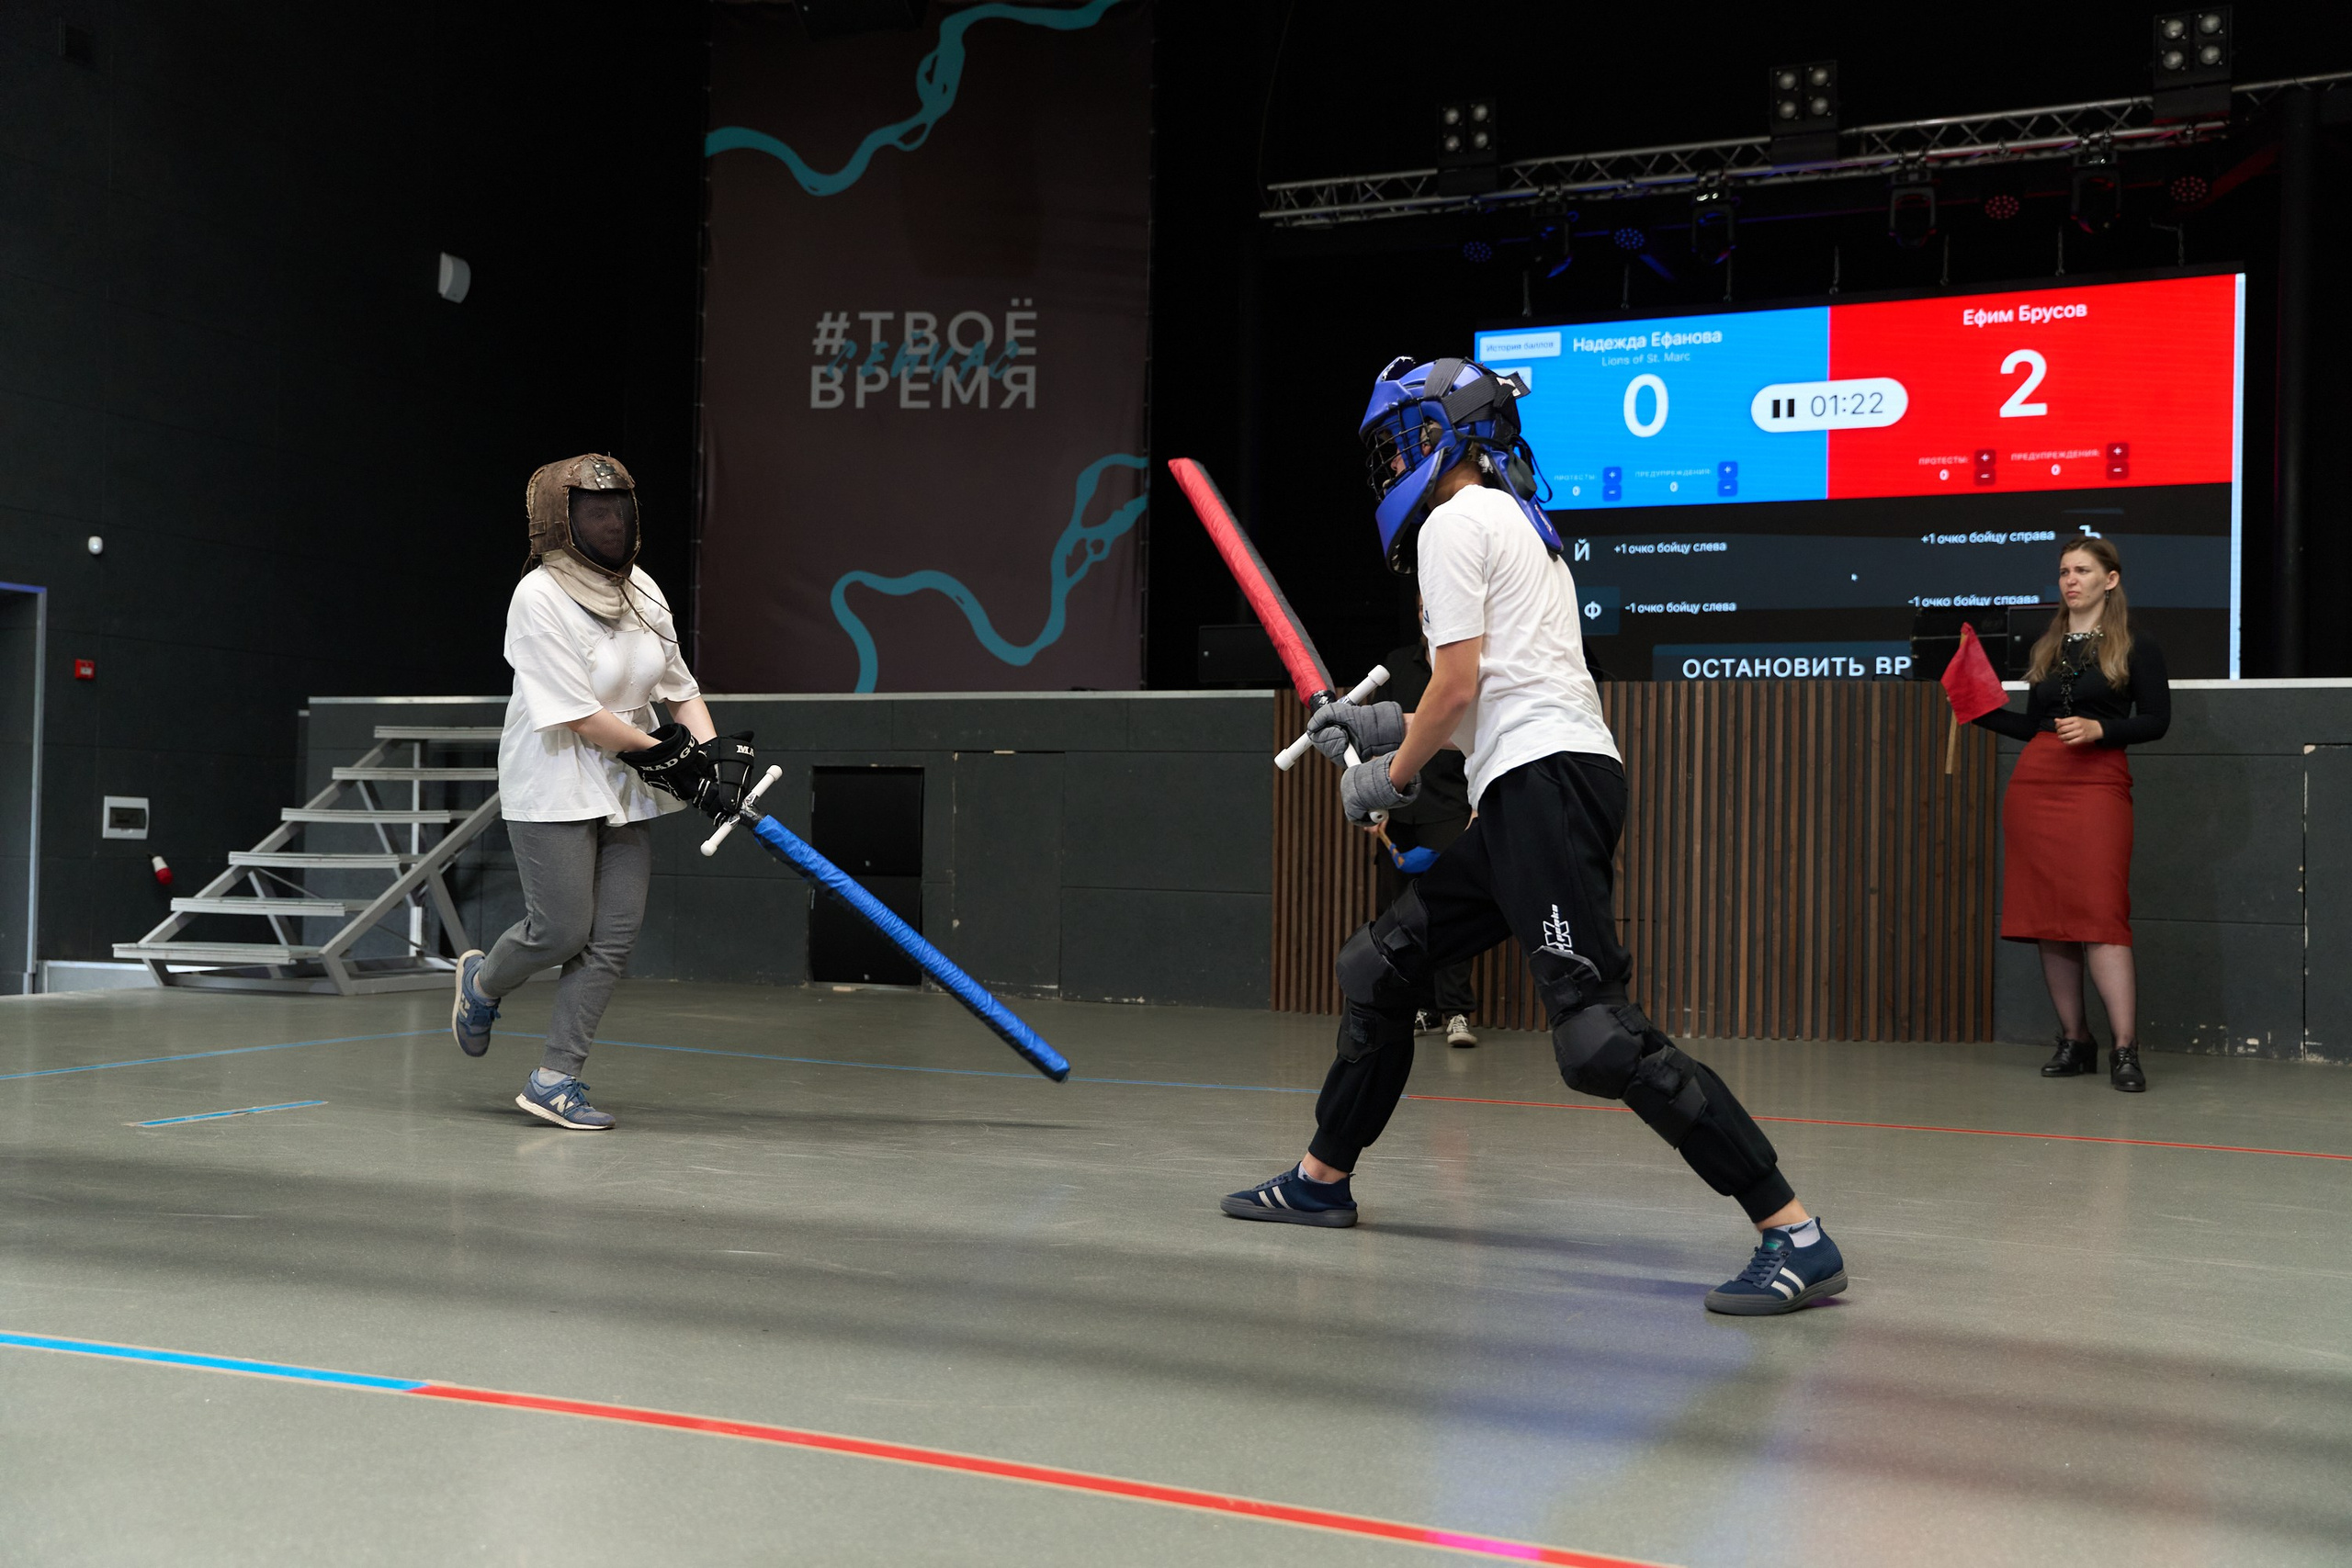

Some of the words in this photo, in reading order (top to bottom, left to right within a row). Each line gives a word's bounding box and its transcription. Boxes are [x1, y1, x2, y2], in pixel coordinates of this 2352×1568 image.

[1962, 308, 2014, 328] Ефим
[2018, 303, 2087, 324] Брусов
[812, 298, 1037, 355] #ТВОЁ
[1486, 344, 1522, 353] История
[1573, 336, 1647, 354] Надежда
[1651, 330, 1723, 349] Ефанова
[1601, 356, 1630, 367] Lions
[1633, 355, 1644, 365] of
[1646, 354, 1660, 364] St.
[1664, 352, 1690, 362] Marc
[810, 366, 1036, 409] ВРЕМЯ
[1999, 348, 2048, 418] 2
[1623, 373, 1669, 437] 0
[1810, 391, 1883, 417] 01:22
[1939, 468, 1950, 480] 0
[2051, 463, 2062, 476] 0
[1572, 485, 1581, 496] 0
[1669, 481, 1679, 492] 0
[1920, 533, 1936, 544] +1
[1937, 534, 1968, 545] очко
[1969, 530, 2008, 545] бойцу
[2008, 530, 2056, 544] справа
[1574, 538, 1590, 562] Й
[1613, 543, 1627, 554] +1
[1628, 544, 1656, 555] очко
[1657, 541, 1692, 555] бойцу
[1692, 542, 1728, 552] слева
[1637, 604, 1665, 614] очко
[1666, 601, 1701, 615] бойцу
[1702, 602, 1737, 613] слева
[1921, 597, 1951, 608] очко
[1583, 601, 1602, 620] Ф
[1682, 656, 1866, 679] ОСТАНОВИТЬ
[640, 758, 678, 771] MAD
